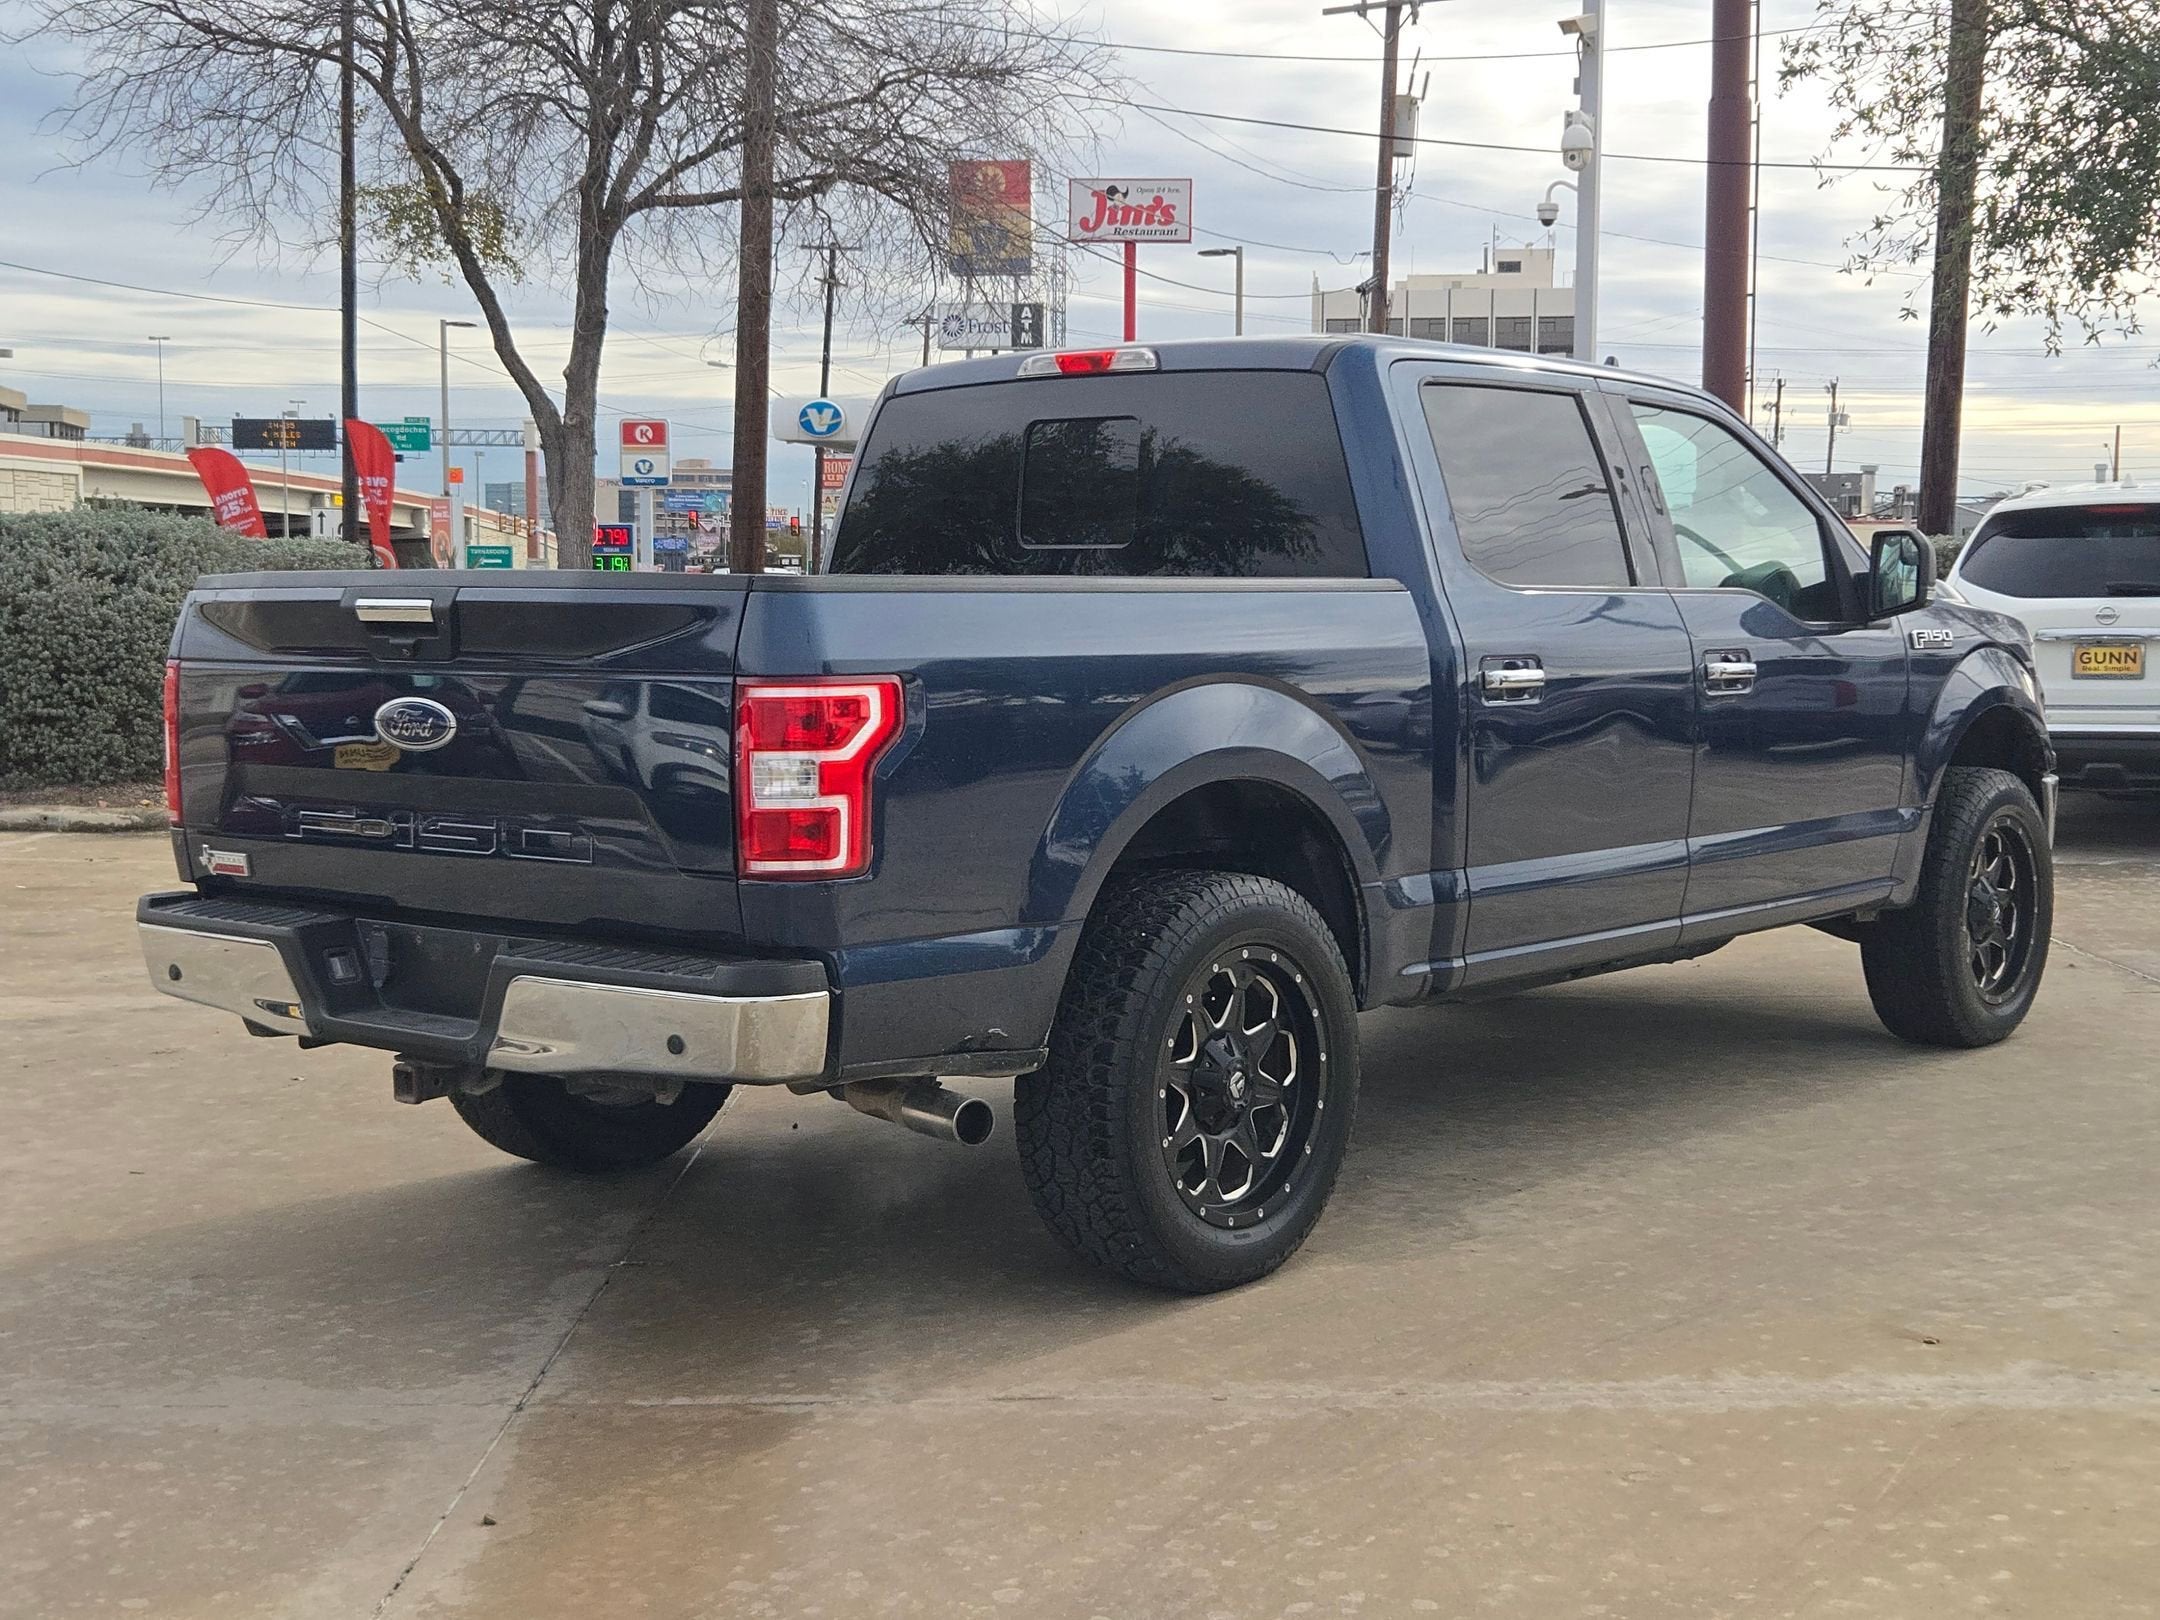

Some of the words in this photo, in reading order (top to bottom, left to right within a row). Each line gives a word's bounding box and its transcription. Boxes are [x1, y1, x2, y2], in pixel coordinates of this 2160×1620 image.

[1136, 187, 1154, 195] Open
[1079, 190, 1177, 234] Jim's
[1113, 227, 1179, 236] Restaurant
[968, 318, 1010, 334] Frost
[1020, 306, 1033, 344] ATM
[2079, 651, 2137, 665] GUNN
[390, 707, 434, 738] Ford
